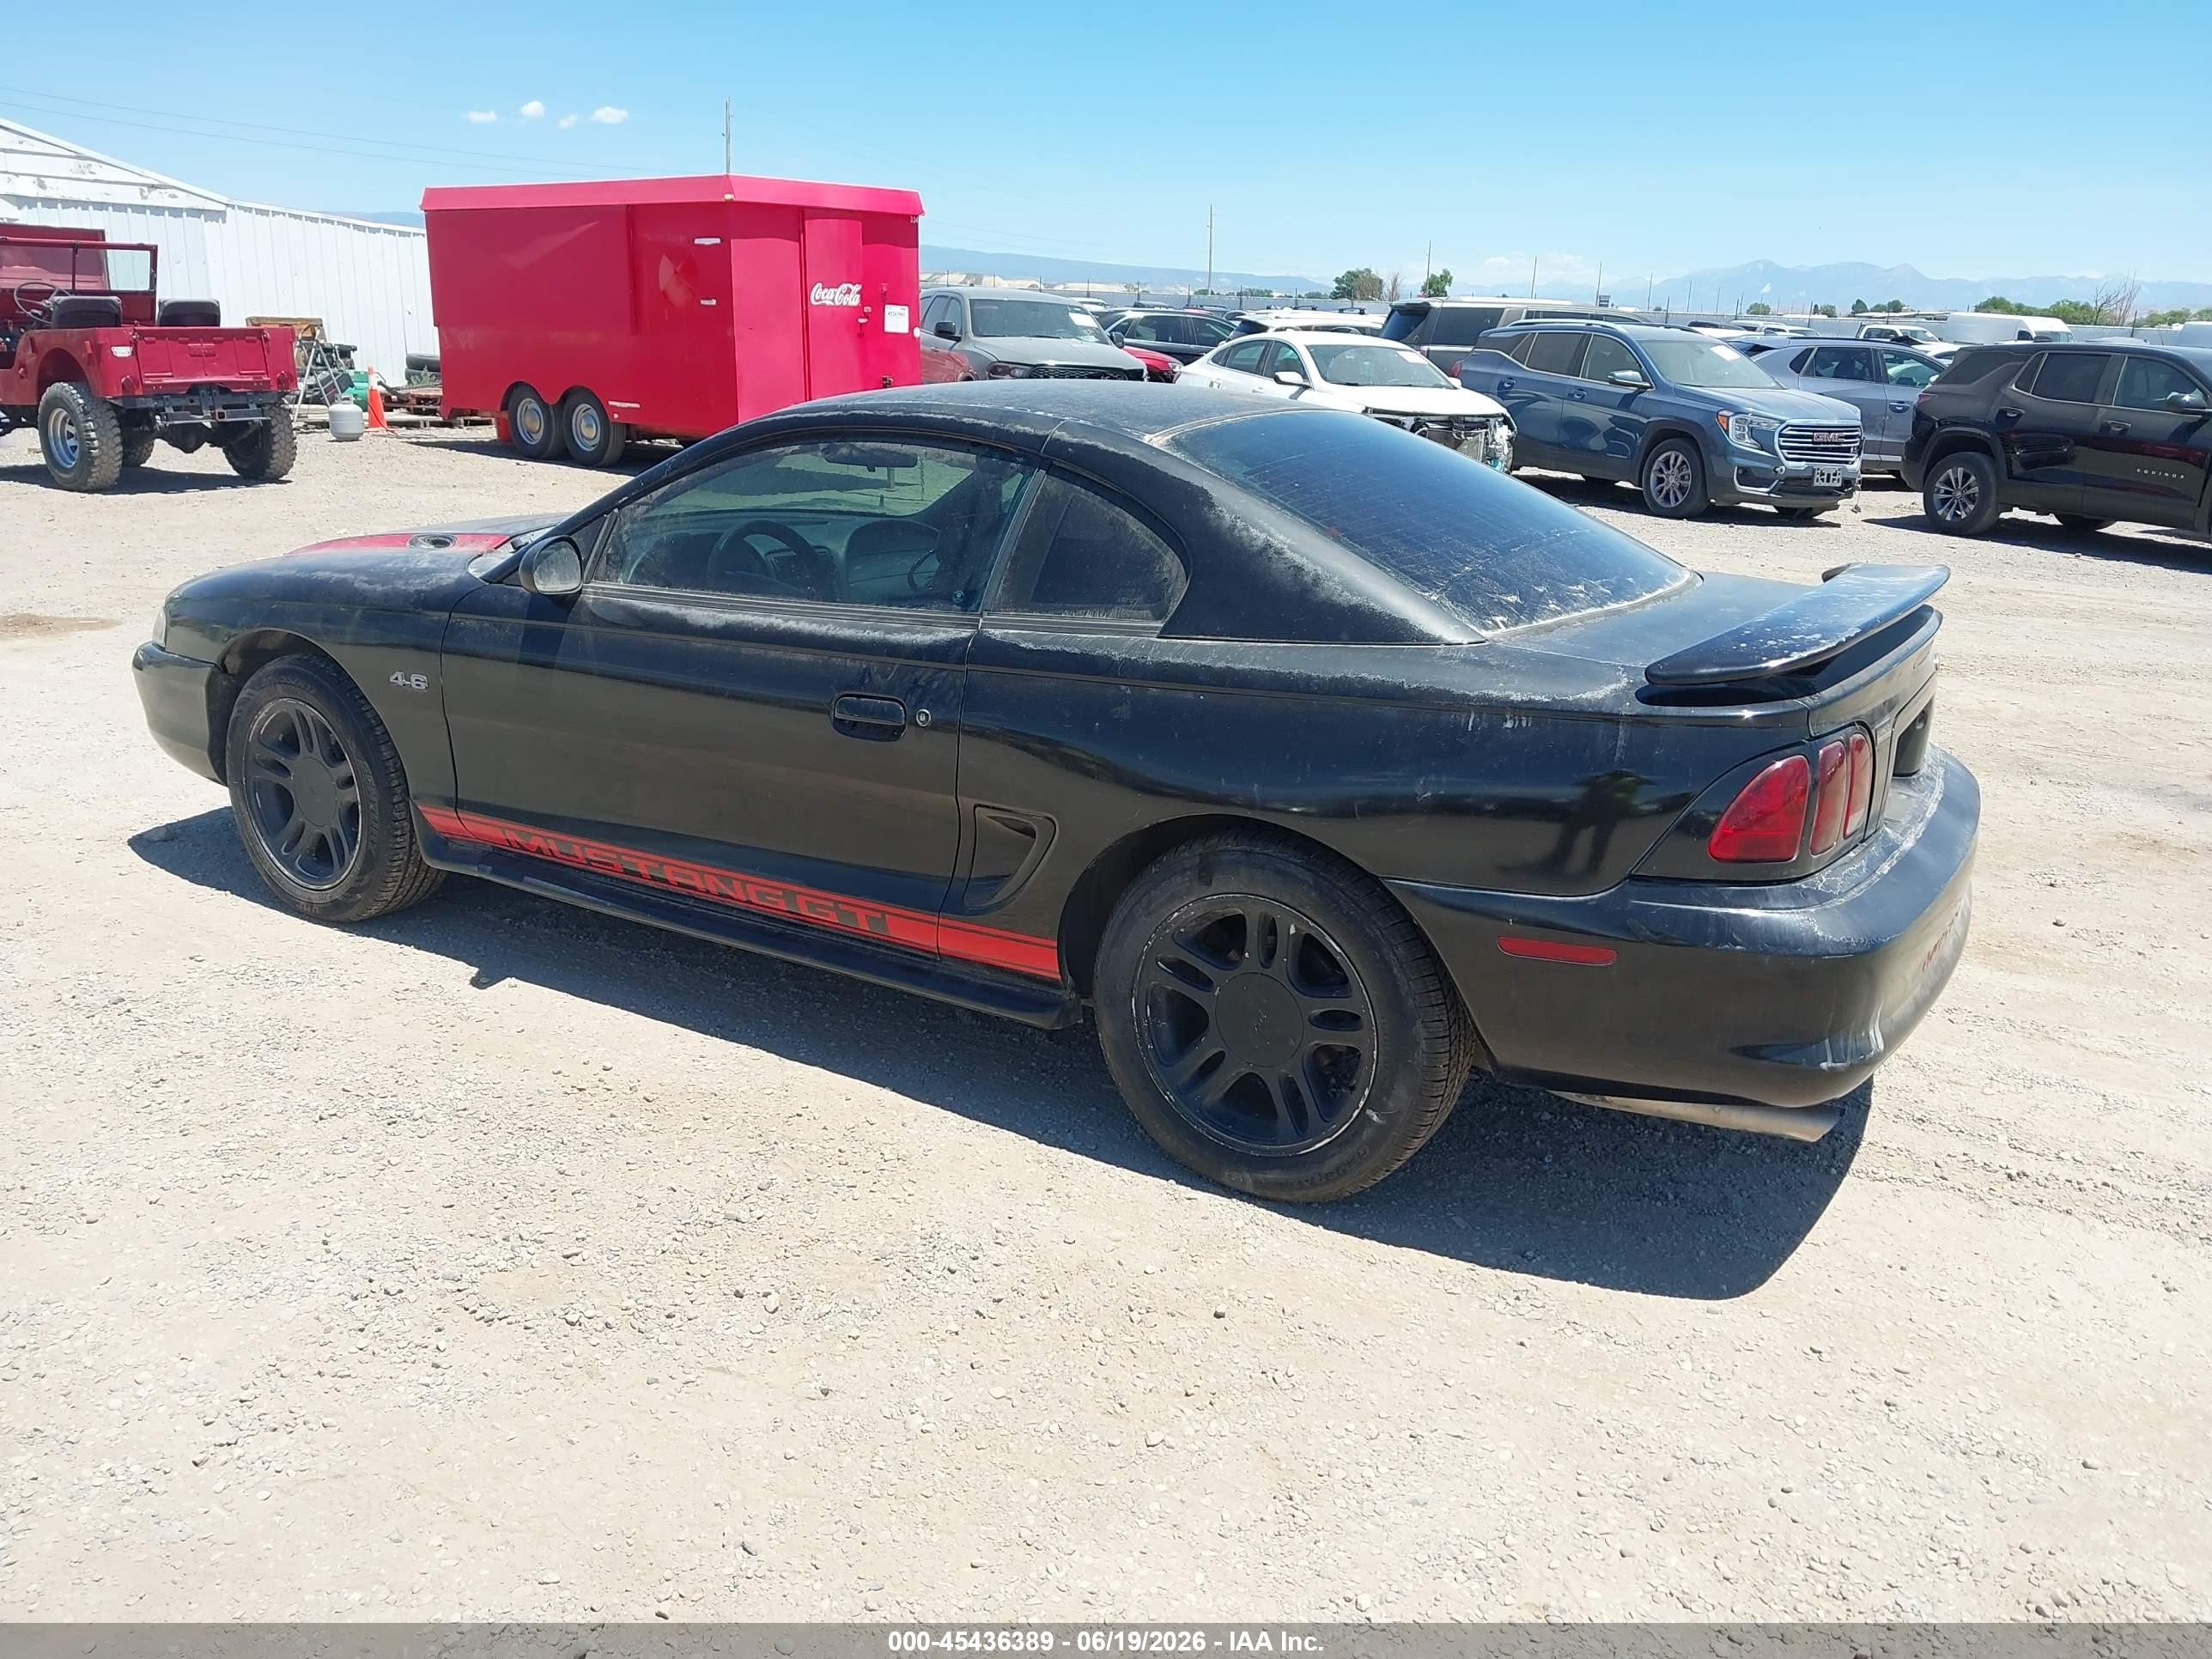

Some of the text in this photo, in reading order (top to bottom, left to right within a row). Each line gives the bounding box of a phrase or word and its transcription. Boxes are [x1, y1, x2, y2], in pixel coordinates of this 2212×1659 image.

[811, 283, 862, 307] Coca-Cola
[1813, 432, 1845, 441] GMC
[503, 830, 882, 932] MUSTANG GT
